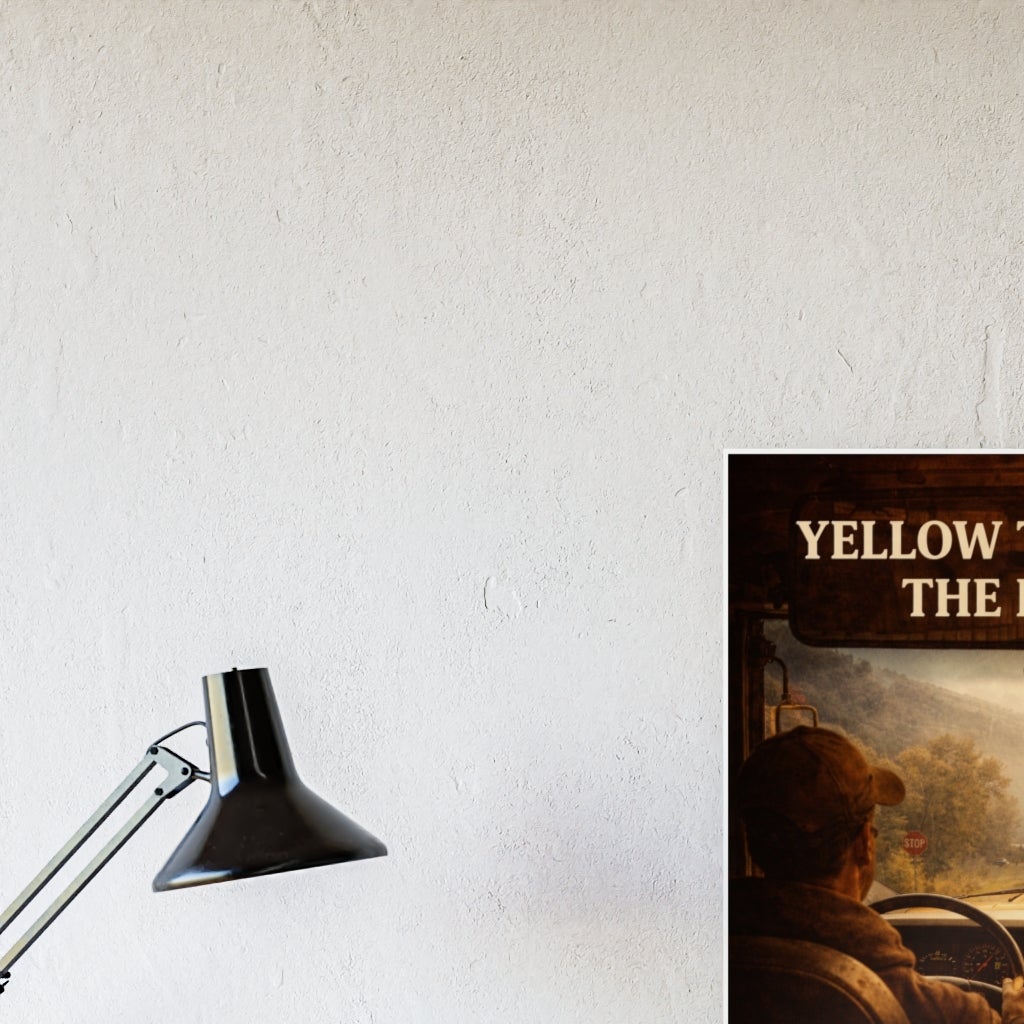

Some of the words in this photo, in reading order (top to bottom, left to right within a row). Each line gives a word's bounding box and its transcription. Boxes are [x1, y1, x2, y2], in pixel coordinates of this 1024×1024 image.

[796, 520, 1003, 560] YELLOW
[901, 578, 1002, 618] THE
[903, 838, 926, 848] STOP
